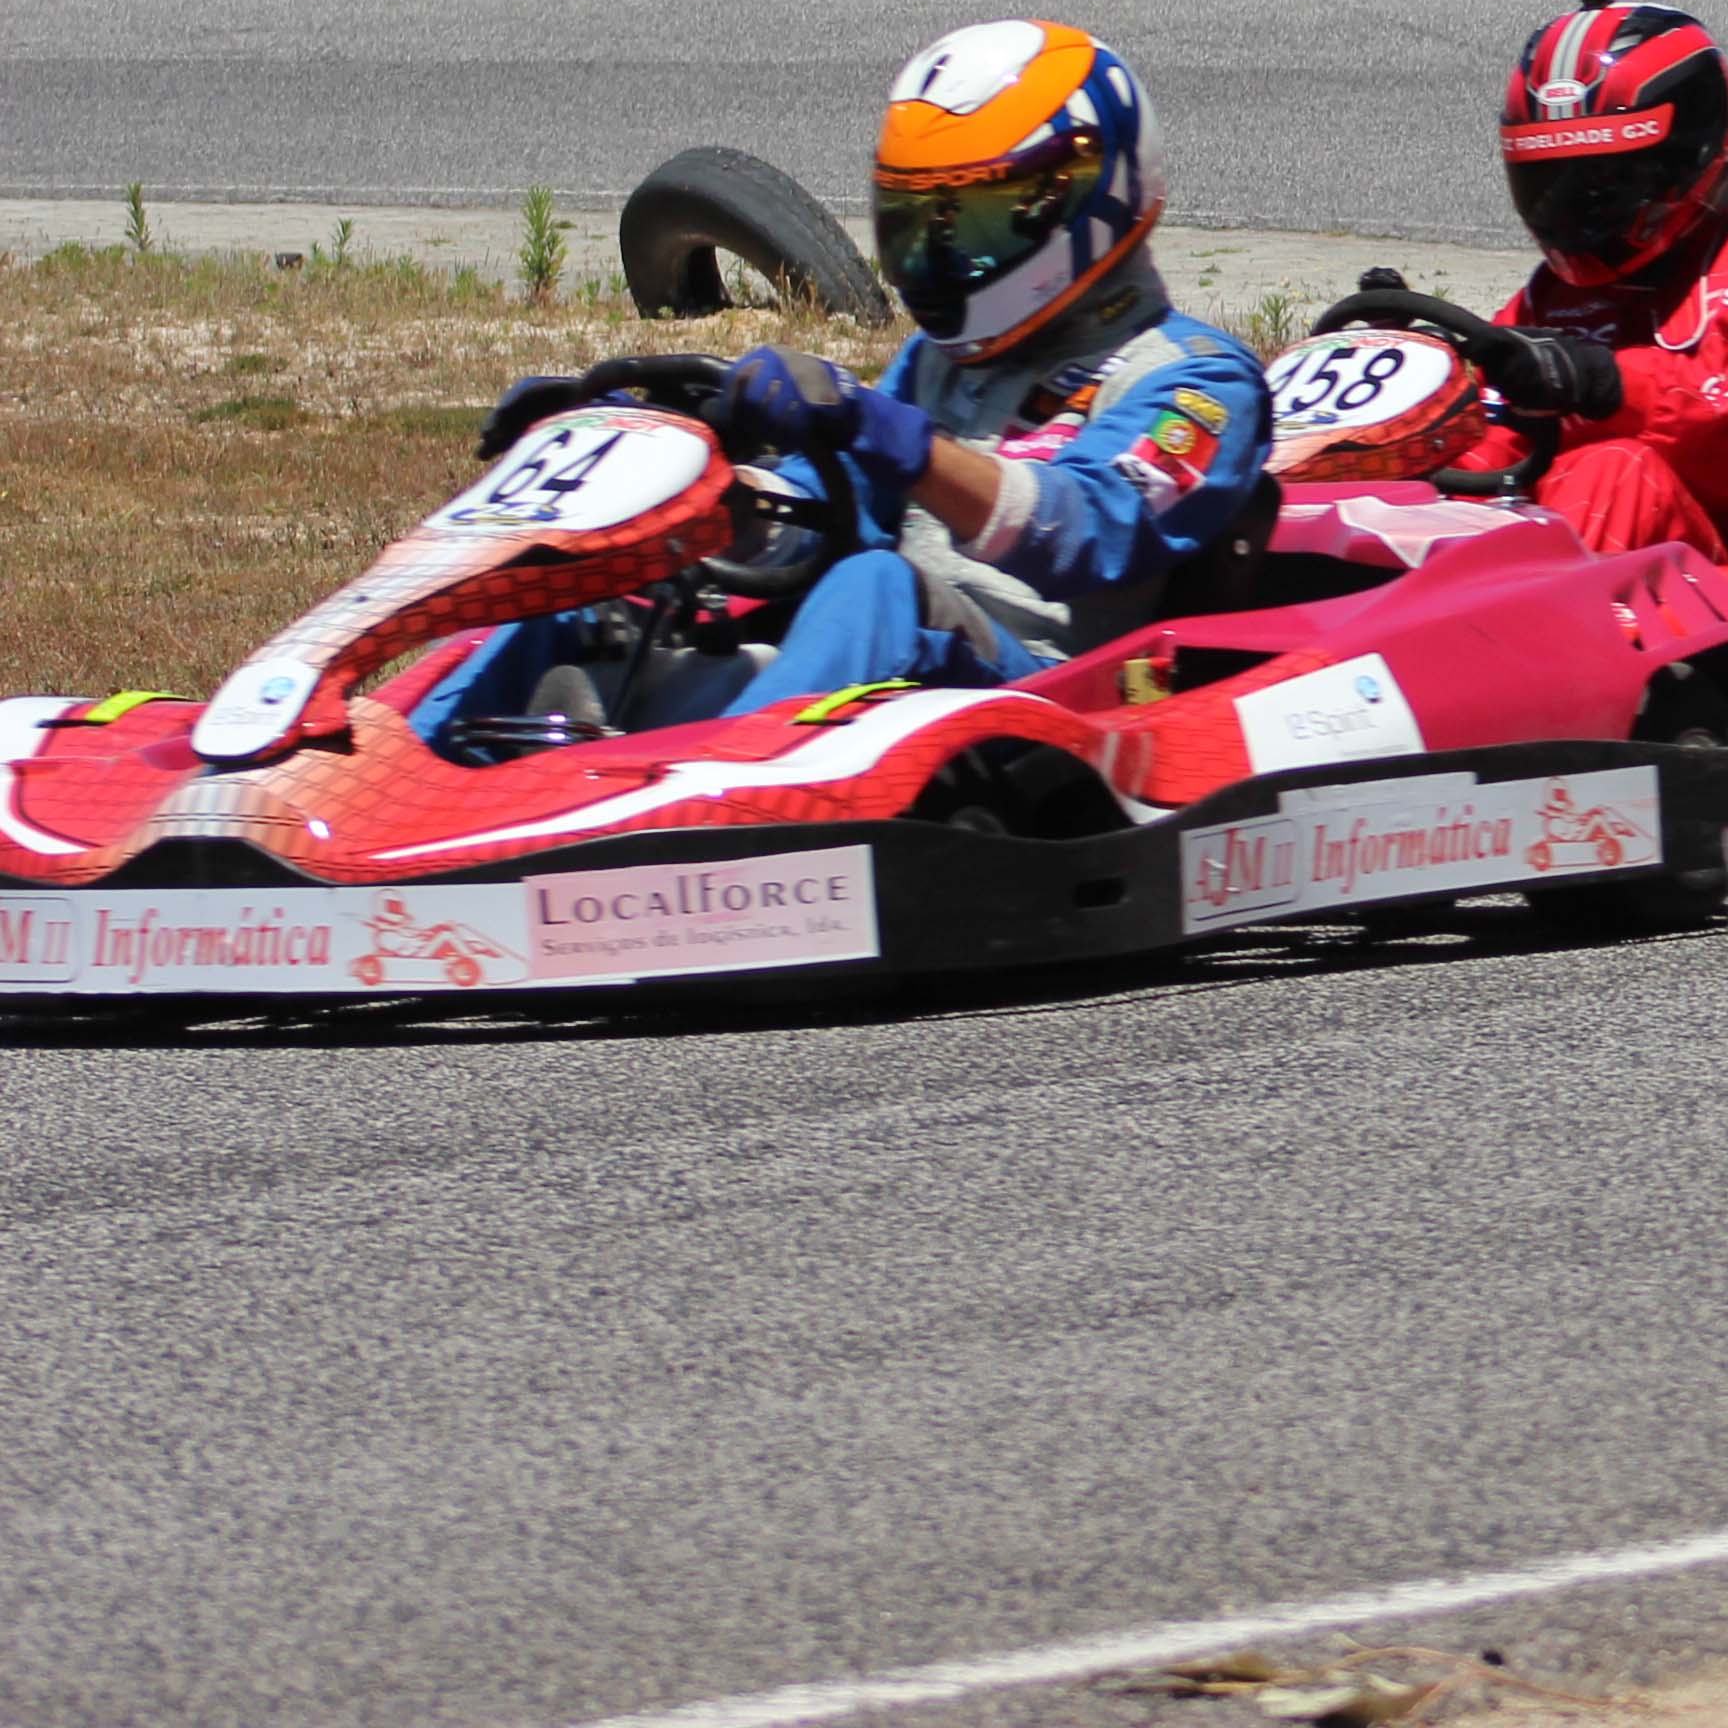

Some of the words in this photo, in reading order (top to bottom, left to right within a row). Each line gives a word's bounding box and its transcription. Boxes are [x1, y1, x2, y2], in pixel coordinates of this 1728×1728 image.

[487, 429, 626, 507] 64
[1311, 804, 1513, 894] Informática
[91, 906, 333, 984] Informática
